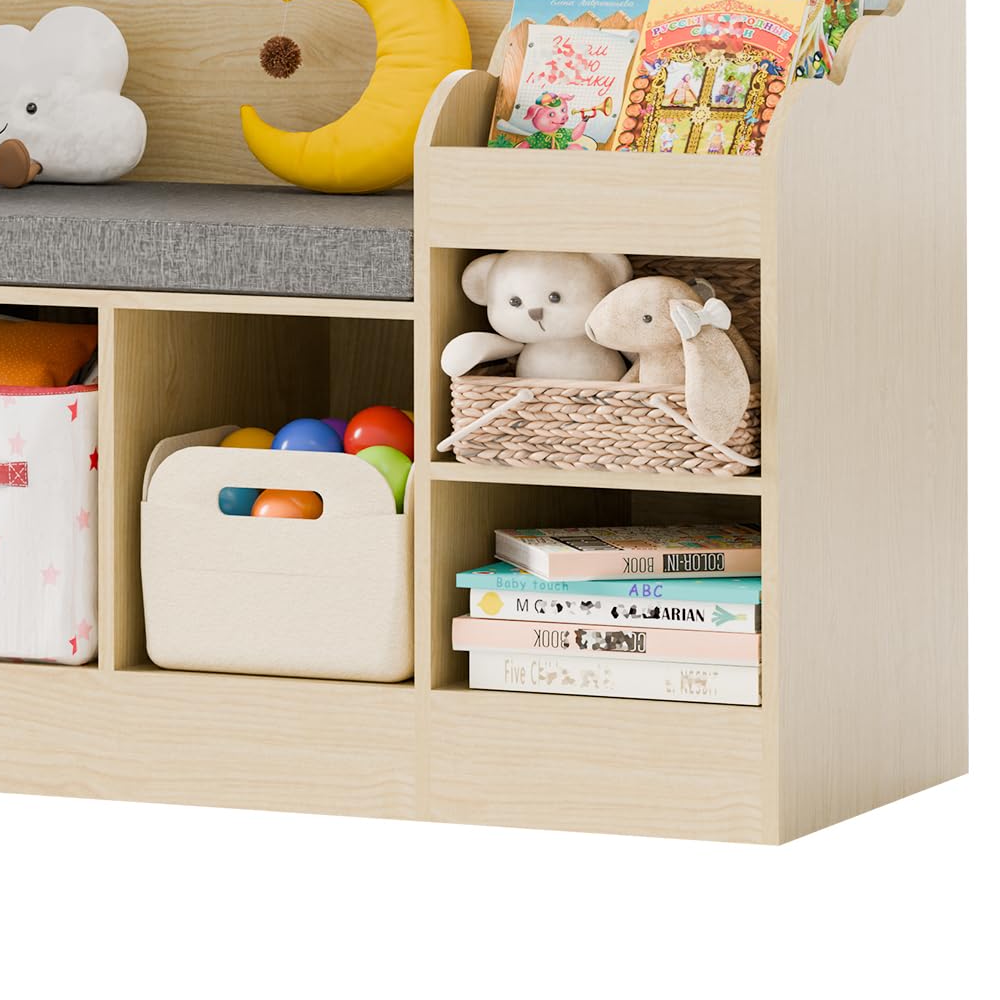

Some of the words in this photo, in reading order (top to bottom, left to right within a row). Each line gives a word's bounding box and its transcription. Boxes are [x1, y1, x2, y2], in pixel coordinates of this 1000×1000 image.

[623, 557, 654, 573] BOOK
[496, 577, 526, 591] Baby
[533, 581, 569, 591] touch
[628, 583, 664, 598] ABC
[504, 658, 526, 685] Five
